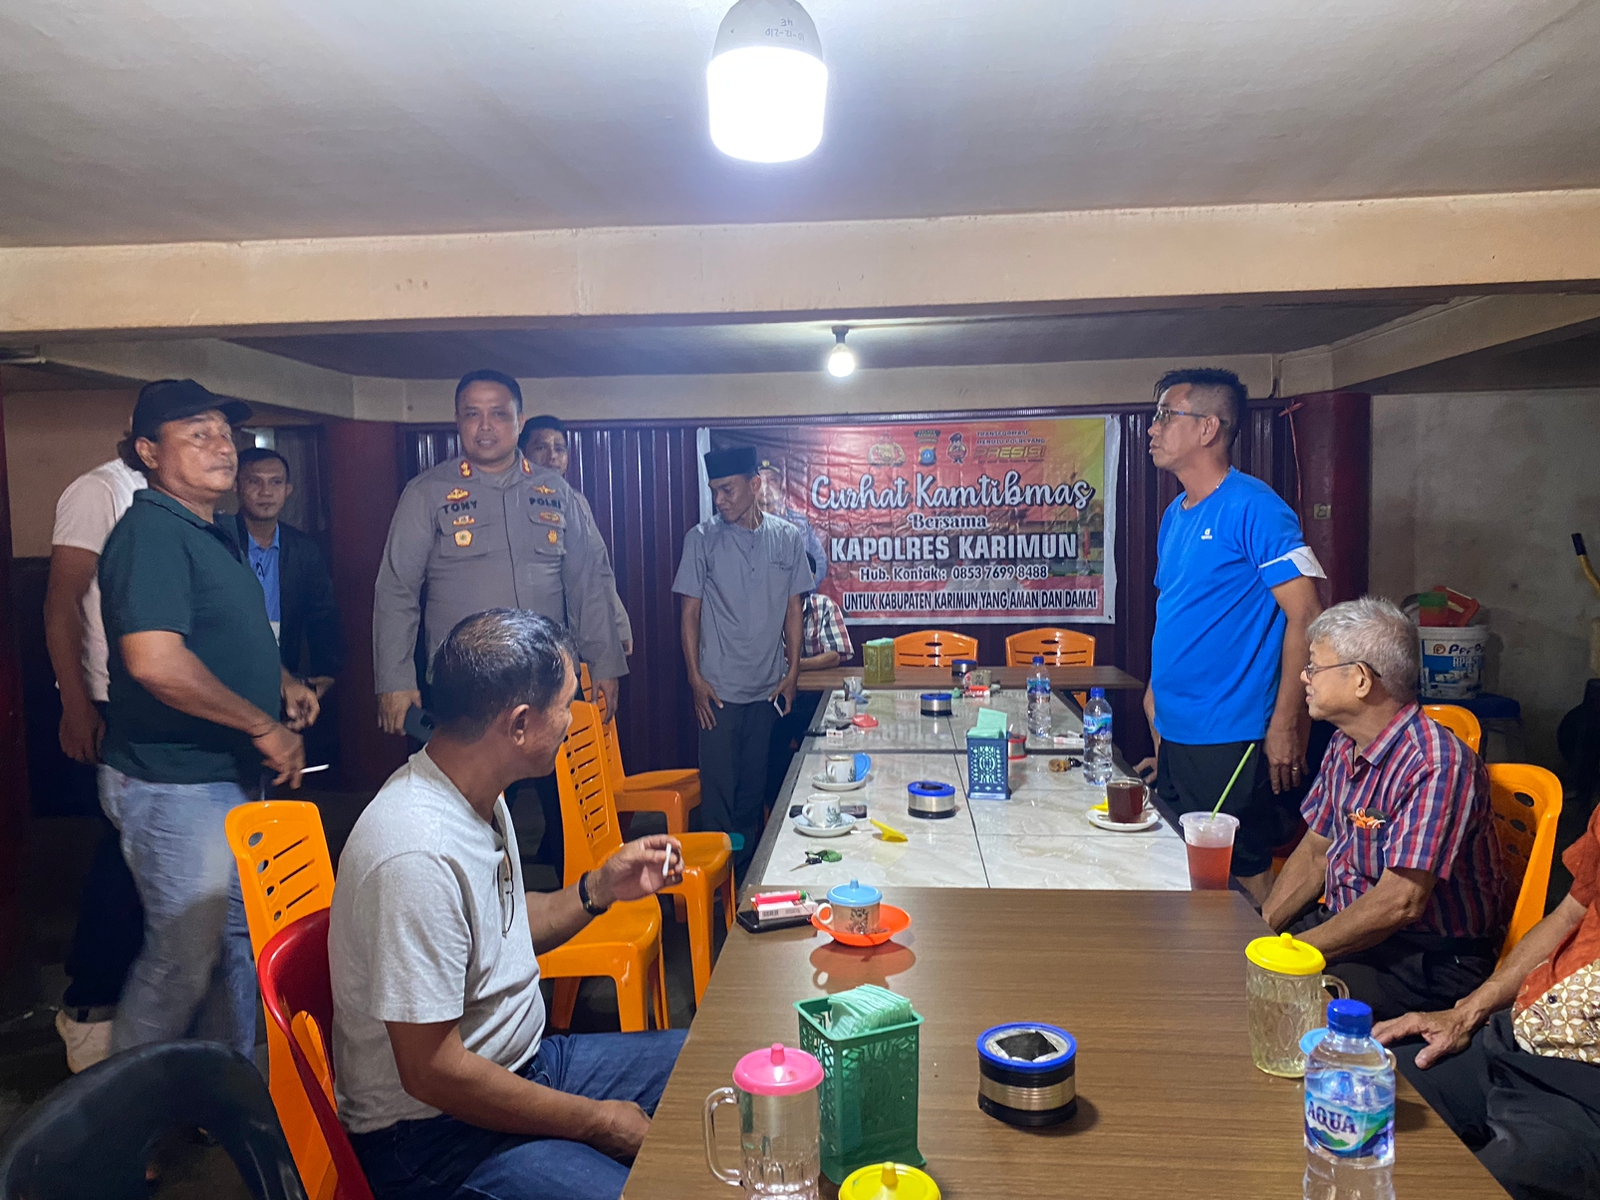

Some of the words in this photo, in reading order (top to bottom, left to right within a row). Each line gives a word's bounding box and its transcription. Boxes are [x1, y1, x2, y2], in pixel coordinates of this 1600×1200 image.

[973, 445, 1047, 460] PRESISI
[811, 473, 910, 510] Curhat
[916, 470, 1095, 510] Kamtibmas
[529, 497, 561, 509] POLRI
[907, 512, 988, 530] Bersama
[831, 536, 950, 561] KAPOLRES
[958, 534, 1077, 559] KARIMUN
[860, 567, 890, 581] Hub.
[952, 565, 982, 580] 0853
[985, 564, 1015, 580] 7699
[1016, 564, 1048, 580] 8488
[843, 592, 877, 611] UNTUK
[879, 591, 932, 611] KABUPATEN
[934, 590, 978, 610] KARIMUN
[980, 590, 1008, 610] YANG
[1009, 590, 1039, 609] AMAN
[1041, 590, 1063, 609] DAN
[1064, 589, 1097, 608] DAMAI
[1307, 1101, 1357, 1134] AQUA
